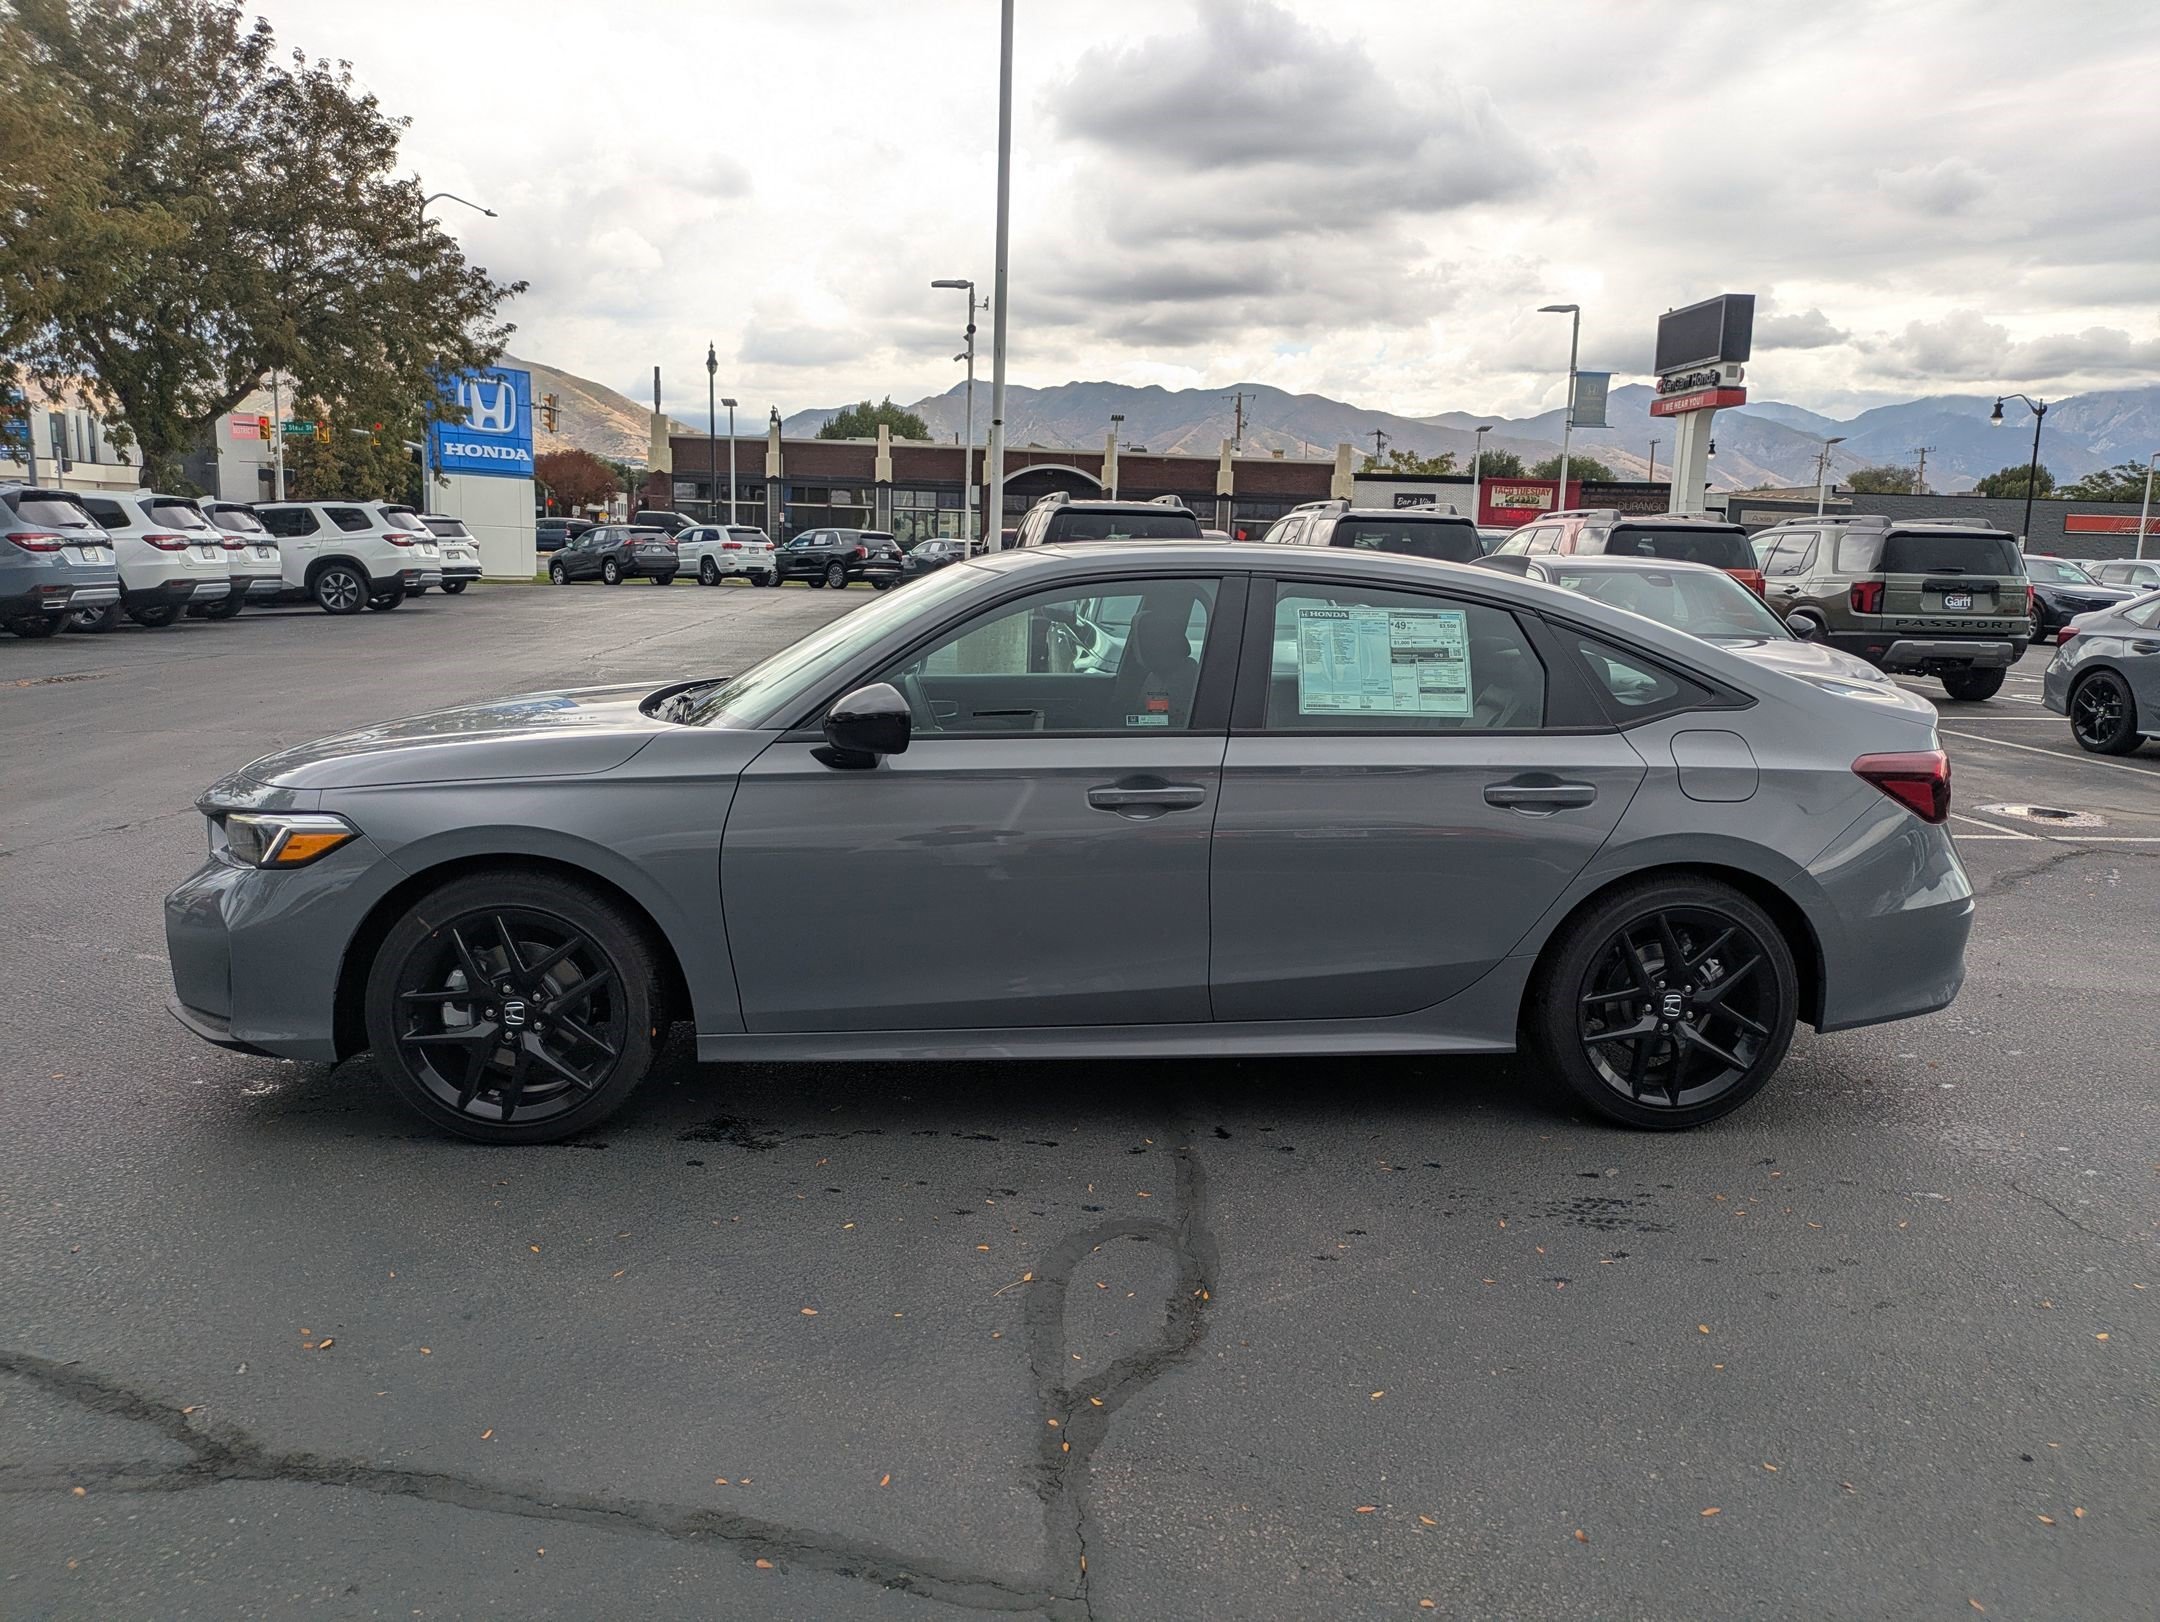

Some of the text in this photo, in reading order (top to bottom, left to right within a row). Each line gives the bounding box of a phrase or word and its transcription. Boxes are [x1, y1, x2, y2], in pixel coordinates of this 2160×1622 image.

[444, 442, 531, 461] HONDA
[1494, 486, 1552, 497] TACO TUESDAY
[1617, 501, 1667, 512] DURANGO
[1944, 595, 1972, 607] Garff
[1394, 621, 1406, 630] 49
[1895, 619, 2017, 629] PASSPORT
